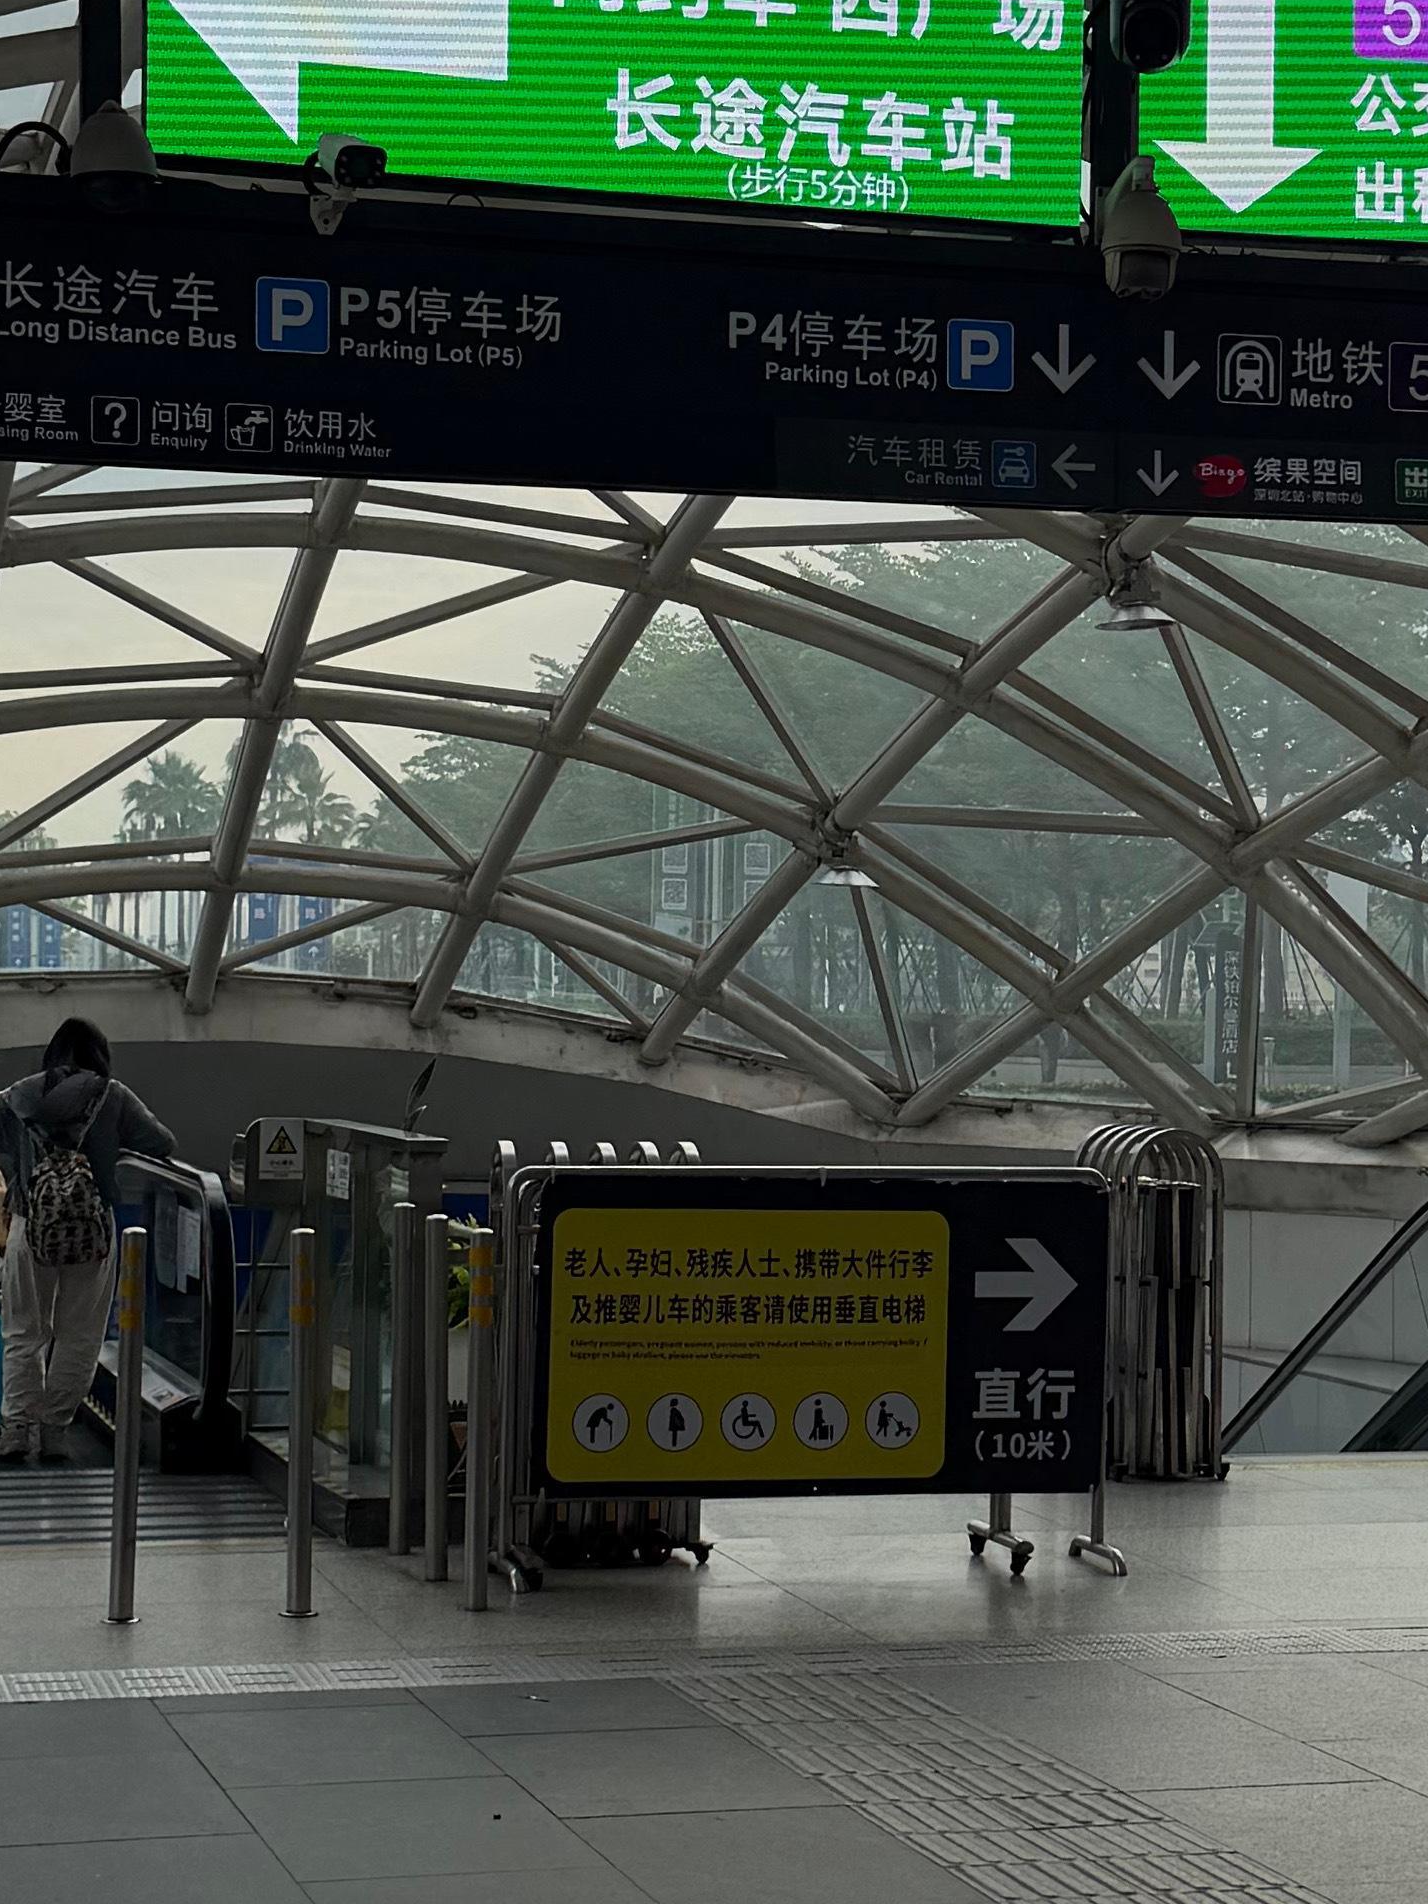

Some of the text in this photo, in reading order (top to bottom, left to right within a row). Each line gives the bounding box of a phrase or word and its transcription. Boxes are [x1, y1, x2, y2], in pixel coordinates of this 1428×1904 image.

[605, 67, 1014, 181] 长途汽车站
[726, 161, 910, 212] (步行5分钟)
[271, 287, 315, 342] P
[340, 286, 562, 343] P5停车场
[69, 319, 180, 347] Distance
[188, 326, 237, 350] Bus
[728, 310, 938, 364] P4停车场
[339, 338, 523, 370] Parking Lot (P5)
[960, 328, 1000, 381] P
[1291, 337, 1385, 387] 地铁
[765, 361, 938, 392] Parking Lot (P4)
[1290, 388, 1353, 410] Metro
[152, 400, 213, 433] 问询
[284, 408, 377, 441] 饮用水
[34, 425, 79, 442] Room
[150, 431, 209, 452] Enquiry
[283, 439, 392, 460] Drinking Water
[847, 434, 983, 469] 汽车租赁
[904, 469, 983, 487] Car Rental
[1253, 457, 1363, 487] 缤果空间
[563, 1246, 935, 1280] 老人、孕妇、残疾人士、携带大件行李
[569, 1292, 927, 1326] 及推婴儿车的乘客请使用垂直电梯
[972, 1367, 1076, 1421] 直行
